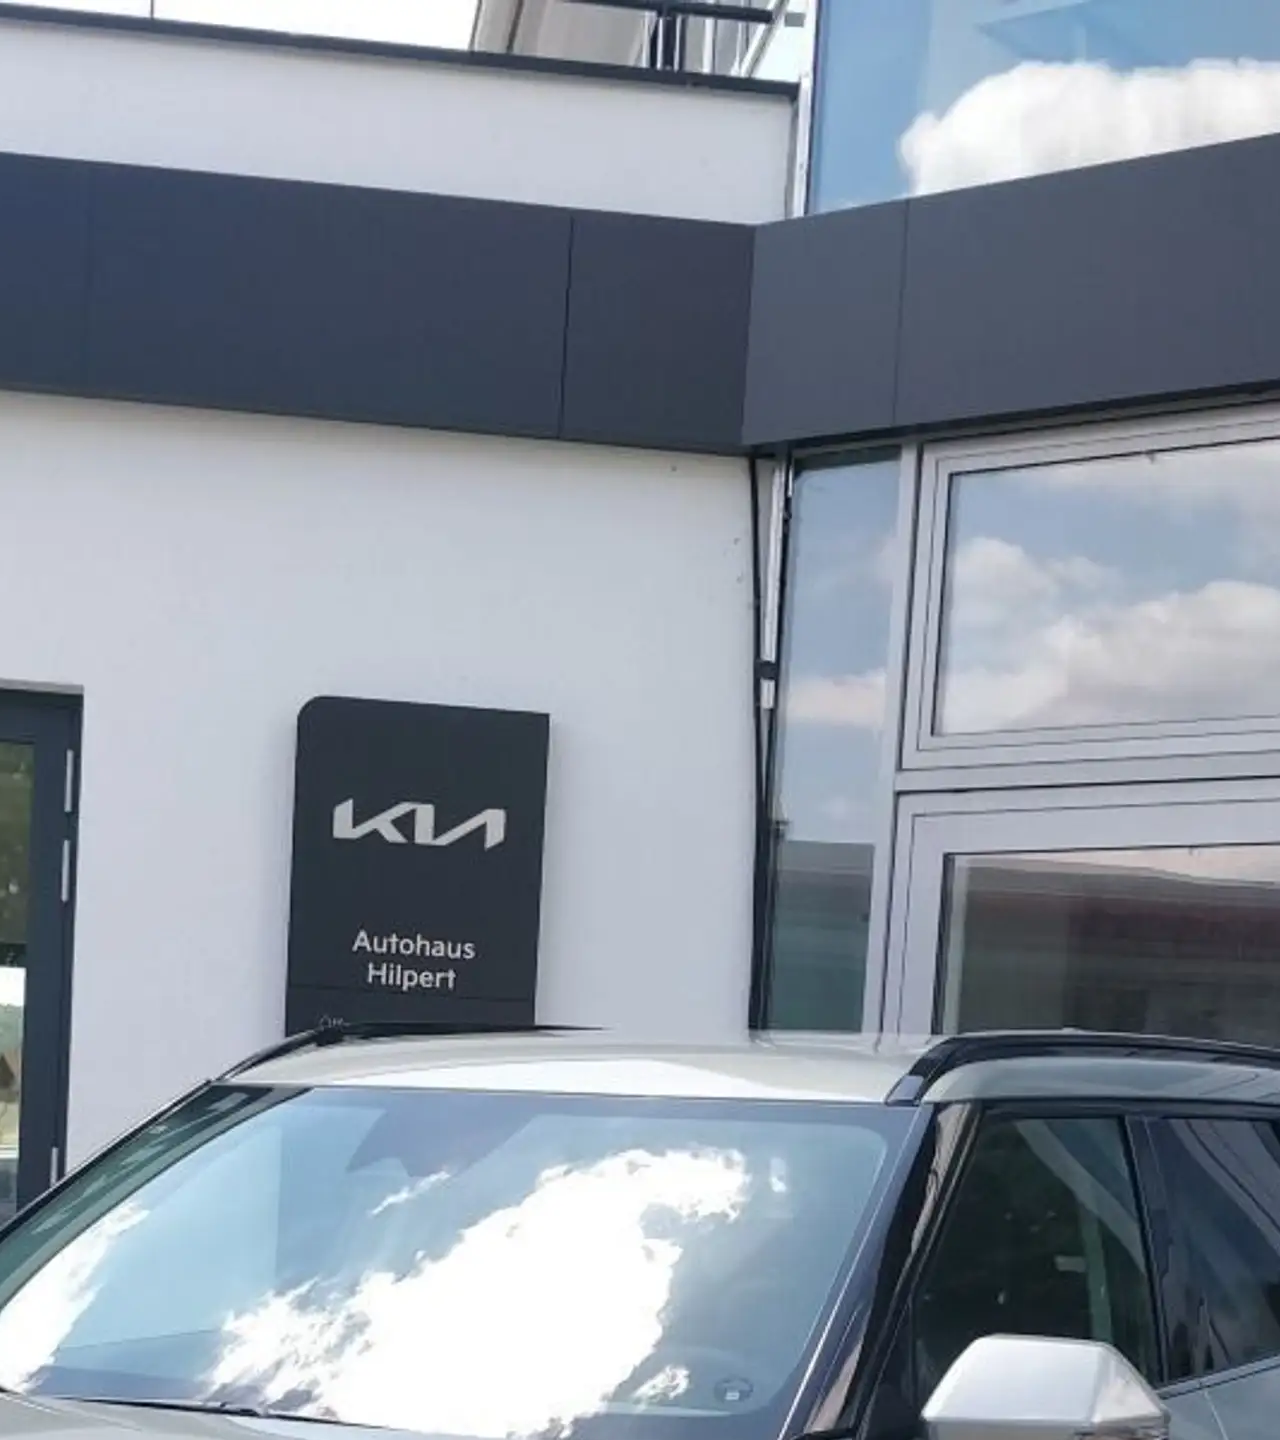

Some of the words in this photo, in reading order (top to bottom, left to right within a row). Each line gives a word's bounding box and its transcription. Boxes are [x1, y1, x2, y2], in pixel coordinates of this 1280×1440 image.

[332, 798, 507, 850] KIA
[352, 930, 476, 960] Autohaus
[366, 962, 456, 991] Hilpert
